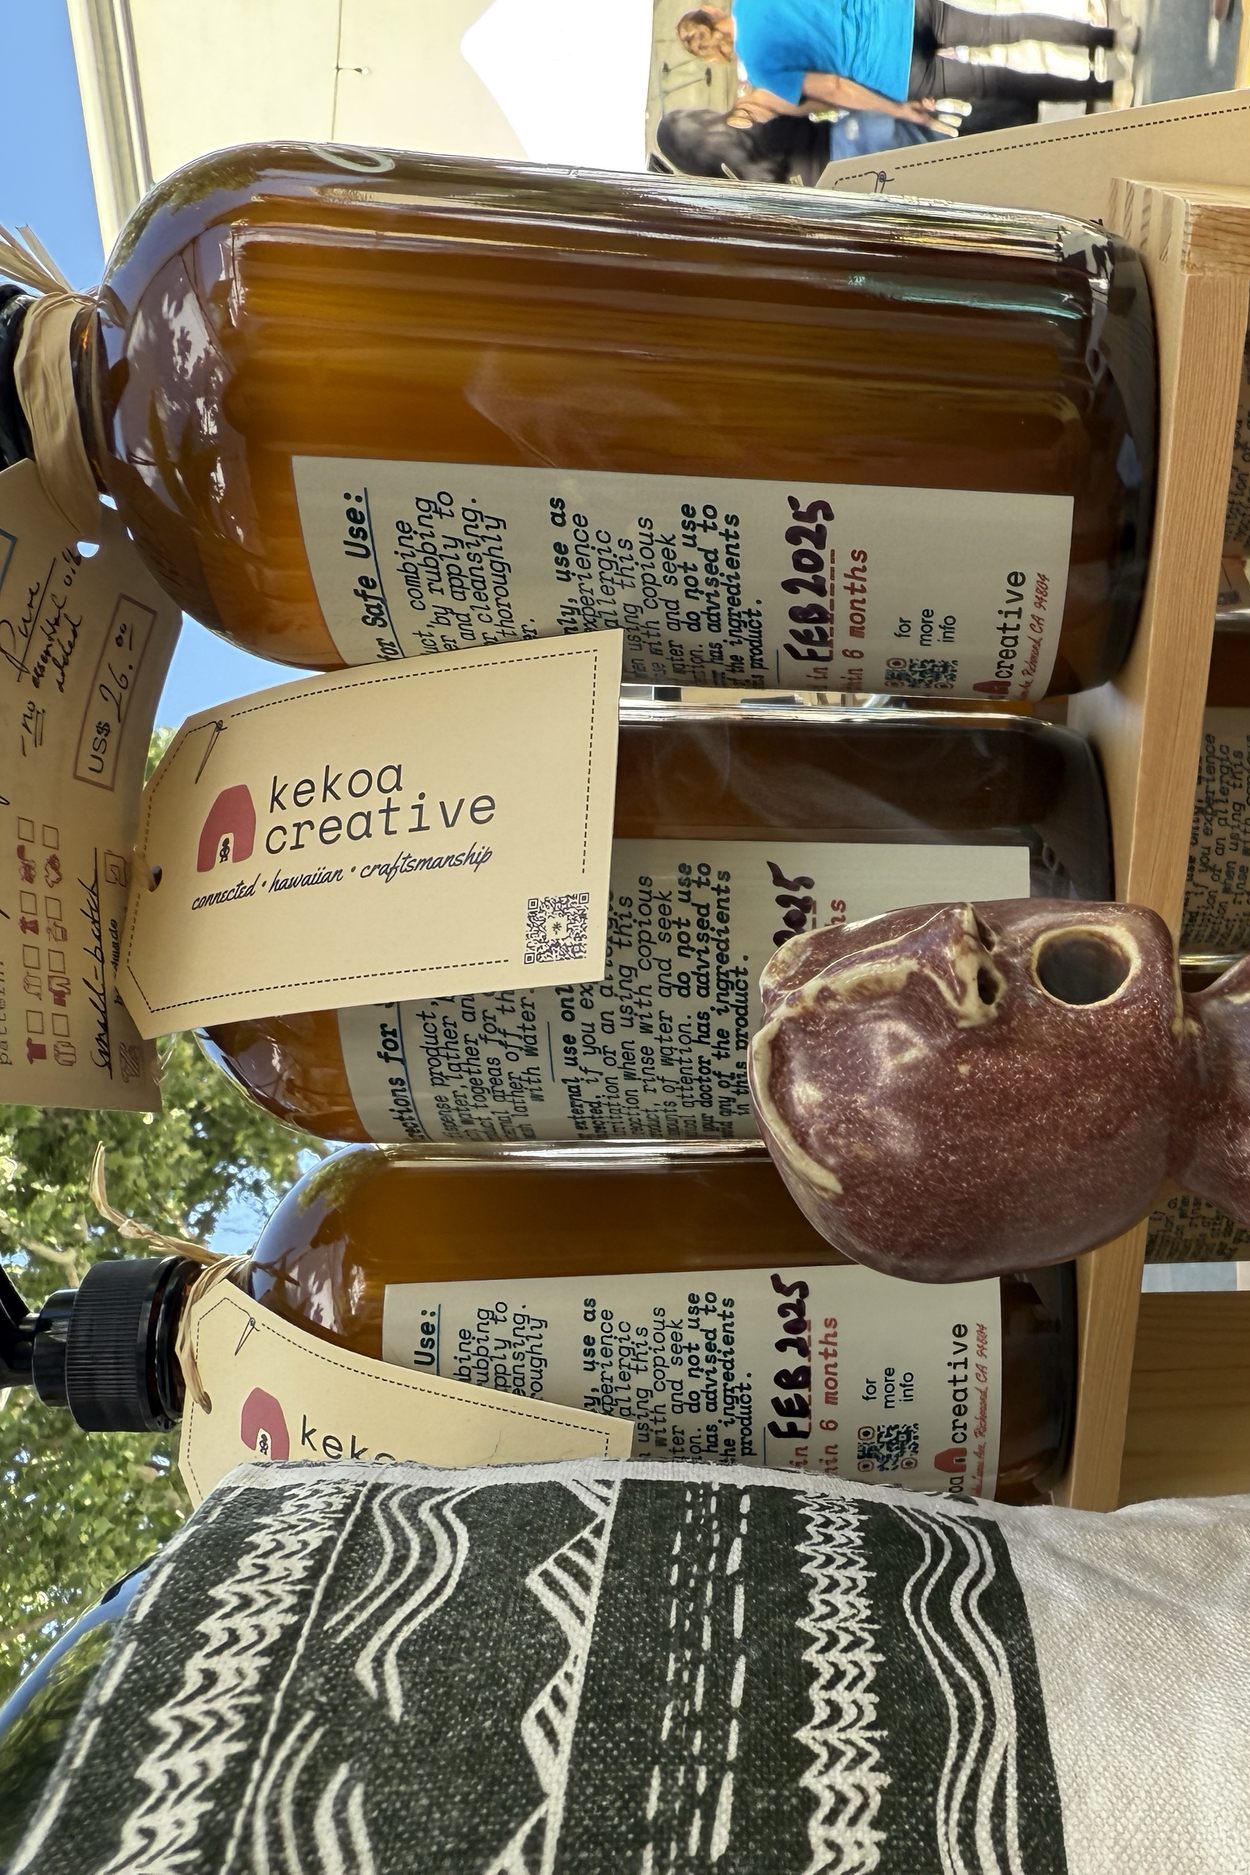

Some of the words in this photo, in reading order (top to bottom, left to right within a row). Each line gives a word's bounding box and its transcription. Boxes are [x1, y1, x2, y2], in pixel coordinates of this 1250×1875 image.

[343, 492, 371, 559] Use:
[434, 491, 455, 519] to
[550, 497, 566, 527] as
[680, 504, 697, 548] use
[697, 504, 718, 532] to
[393, 520, 426, 611] combine
[413, 497, 445, 595] rubbing
[438, 535, 471, 601] apply
[459, 498, 494, 623] cleansing.
[552, 542, 572, 582] use
[613, 538, 636, 589] this
[635, 517, 662, 609] copious
[656, 534, 678, 586] seek
[781, 496, 834, 597] 2025
[477, 515, 518, 637] thoroughly
[591, 530, 619, 629] allergic
[678, 562, 700, 600] not
[697, 547, 722, 633] advised
[719, 513, 747, 646] ingredients
[844, 549, 867, 638] months
[1033, 573, 1049, 611] 94804
[353, 576, 388, 628] Safe
[431, 605, 454, 626] by
[659, 598, 681, 631] and
[679, 611, 701, 632] do
[450, 611, 476, 641] and
[621, 603, 644, 651] using
[743, 599, 769, 670] product.
[782, 603, 834, 662] FEB
[894, 617, 912, 638] for
[919, 609, 934, 647] more
[938, 616, 956, 643] info
[993, 571, 1026, 679] creative
[1029, 616, 1044, 634] CA
[706, 642, 724, 665] has
[724, 655, 745, 673] the
[841, 649, 864, 659] 6
[88, 721, 111, 773] US$
[268, 764, 403, 814] kekoa
[264, 791, 496, 855] creative
[191, 872, 262, 910] connected
[266, 868, 344, 893] hawaiian
[360, 841, 493, 884] craftsmanship
[676, 863, 693, 903] use
[693, 863, 711, 888] to
[613, 896, 633, 949] this
[634, 876, 657, 971] copious
[653, 890, 672, 943] seek
[674, 917, 692, 958] not
[691, 902, 711, 998] advised
[709, 871, 735, 1016] ingredients
[616, 964, 638, 1027] using
[653, 958, 672, 998] and
[673, 971, 692, 998] do
[519, 988, 539, 1056] water.
[600, 1011, 615, 1034] an
[633, 984, 654, 1034] with
[731, 955, 750, 1051] product.
[377, 1023, 405, 1063] for
[416, 1001, 450, 1087] product,
[439, 1016, 462, 1079] lather
[479, 1010, 506, 1044] for
[498, 1028, 524, 1061] off
[581, 1022, 603, 1055] you
[657, 1010, 675, 1066] water
[692, 1011, 712, 1045] has
[710, 1028, 731, 1060] the
[460, 1034, 491, 1109] together
[561, 1034, 577, 1066] use
[603, 1045, 617, 1066] or
[619, 1040, 639, 1080] when
[634, 1045, 656, 1093] rinse
[677, 1014, 697, 1108] attention.
[486, 1057, 506, 1102] areas
[506, 1072, 529, 1117] lather
[521, 1066, 545, 1102] with
[580, 1066, 603, 1084] if
[656, 1075, 678, 1093] of
[695, 1055, 713, 1108] doctor
[711, 1070, 734, 1089] of
[731, 1062, 748, 1096] this
[562, 1077, 589, 1131] external
[718, 1096, 737, 1117] any
[732, 1103, 750, 1116] in
[490, 1302, 508, 1324] to
[583, 1298, 596, 1322] as
[687, 1293, 700, 1329] use
[702, 1292, 718, 1314] to
[770, 1273, 810, 1358] 2025
[414, 1309, 436, 1366] Use:
[583, 1335, 596, 1372] use
[630, 1327, 649, 1375] this
[648, 1307, 668, 1392] copious
[665, 1319, 684, 1366] seek
[613, 1321, 634, 1417] allergic
[681, 1343, 700, 1379] not
[699, 1328, 718, 1413] advised
[718, 1298, 739, 1428] ingredients
[819, 1318, 838, 1406] months
[976, 1365, 987, 1383] CA
[665, 1379, 684, 1414] and
[682, 1391, 700, 1413] do
[767, 1365, 812, 1439] FEB
[862, 1378, 878, 1401] for
[883, 1367, 896, 1409] more
[899, 1372, 915, 1402] info
[947, 1323, 968, 1444] creative
[633, 1388, 652, 1442] using
[648, 1404, 667, 1447] with
[737, 1372, 757, 1456] product.
[819, 1419, 838, 1431] 6
[700, 1424, 718, 1453] has
